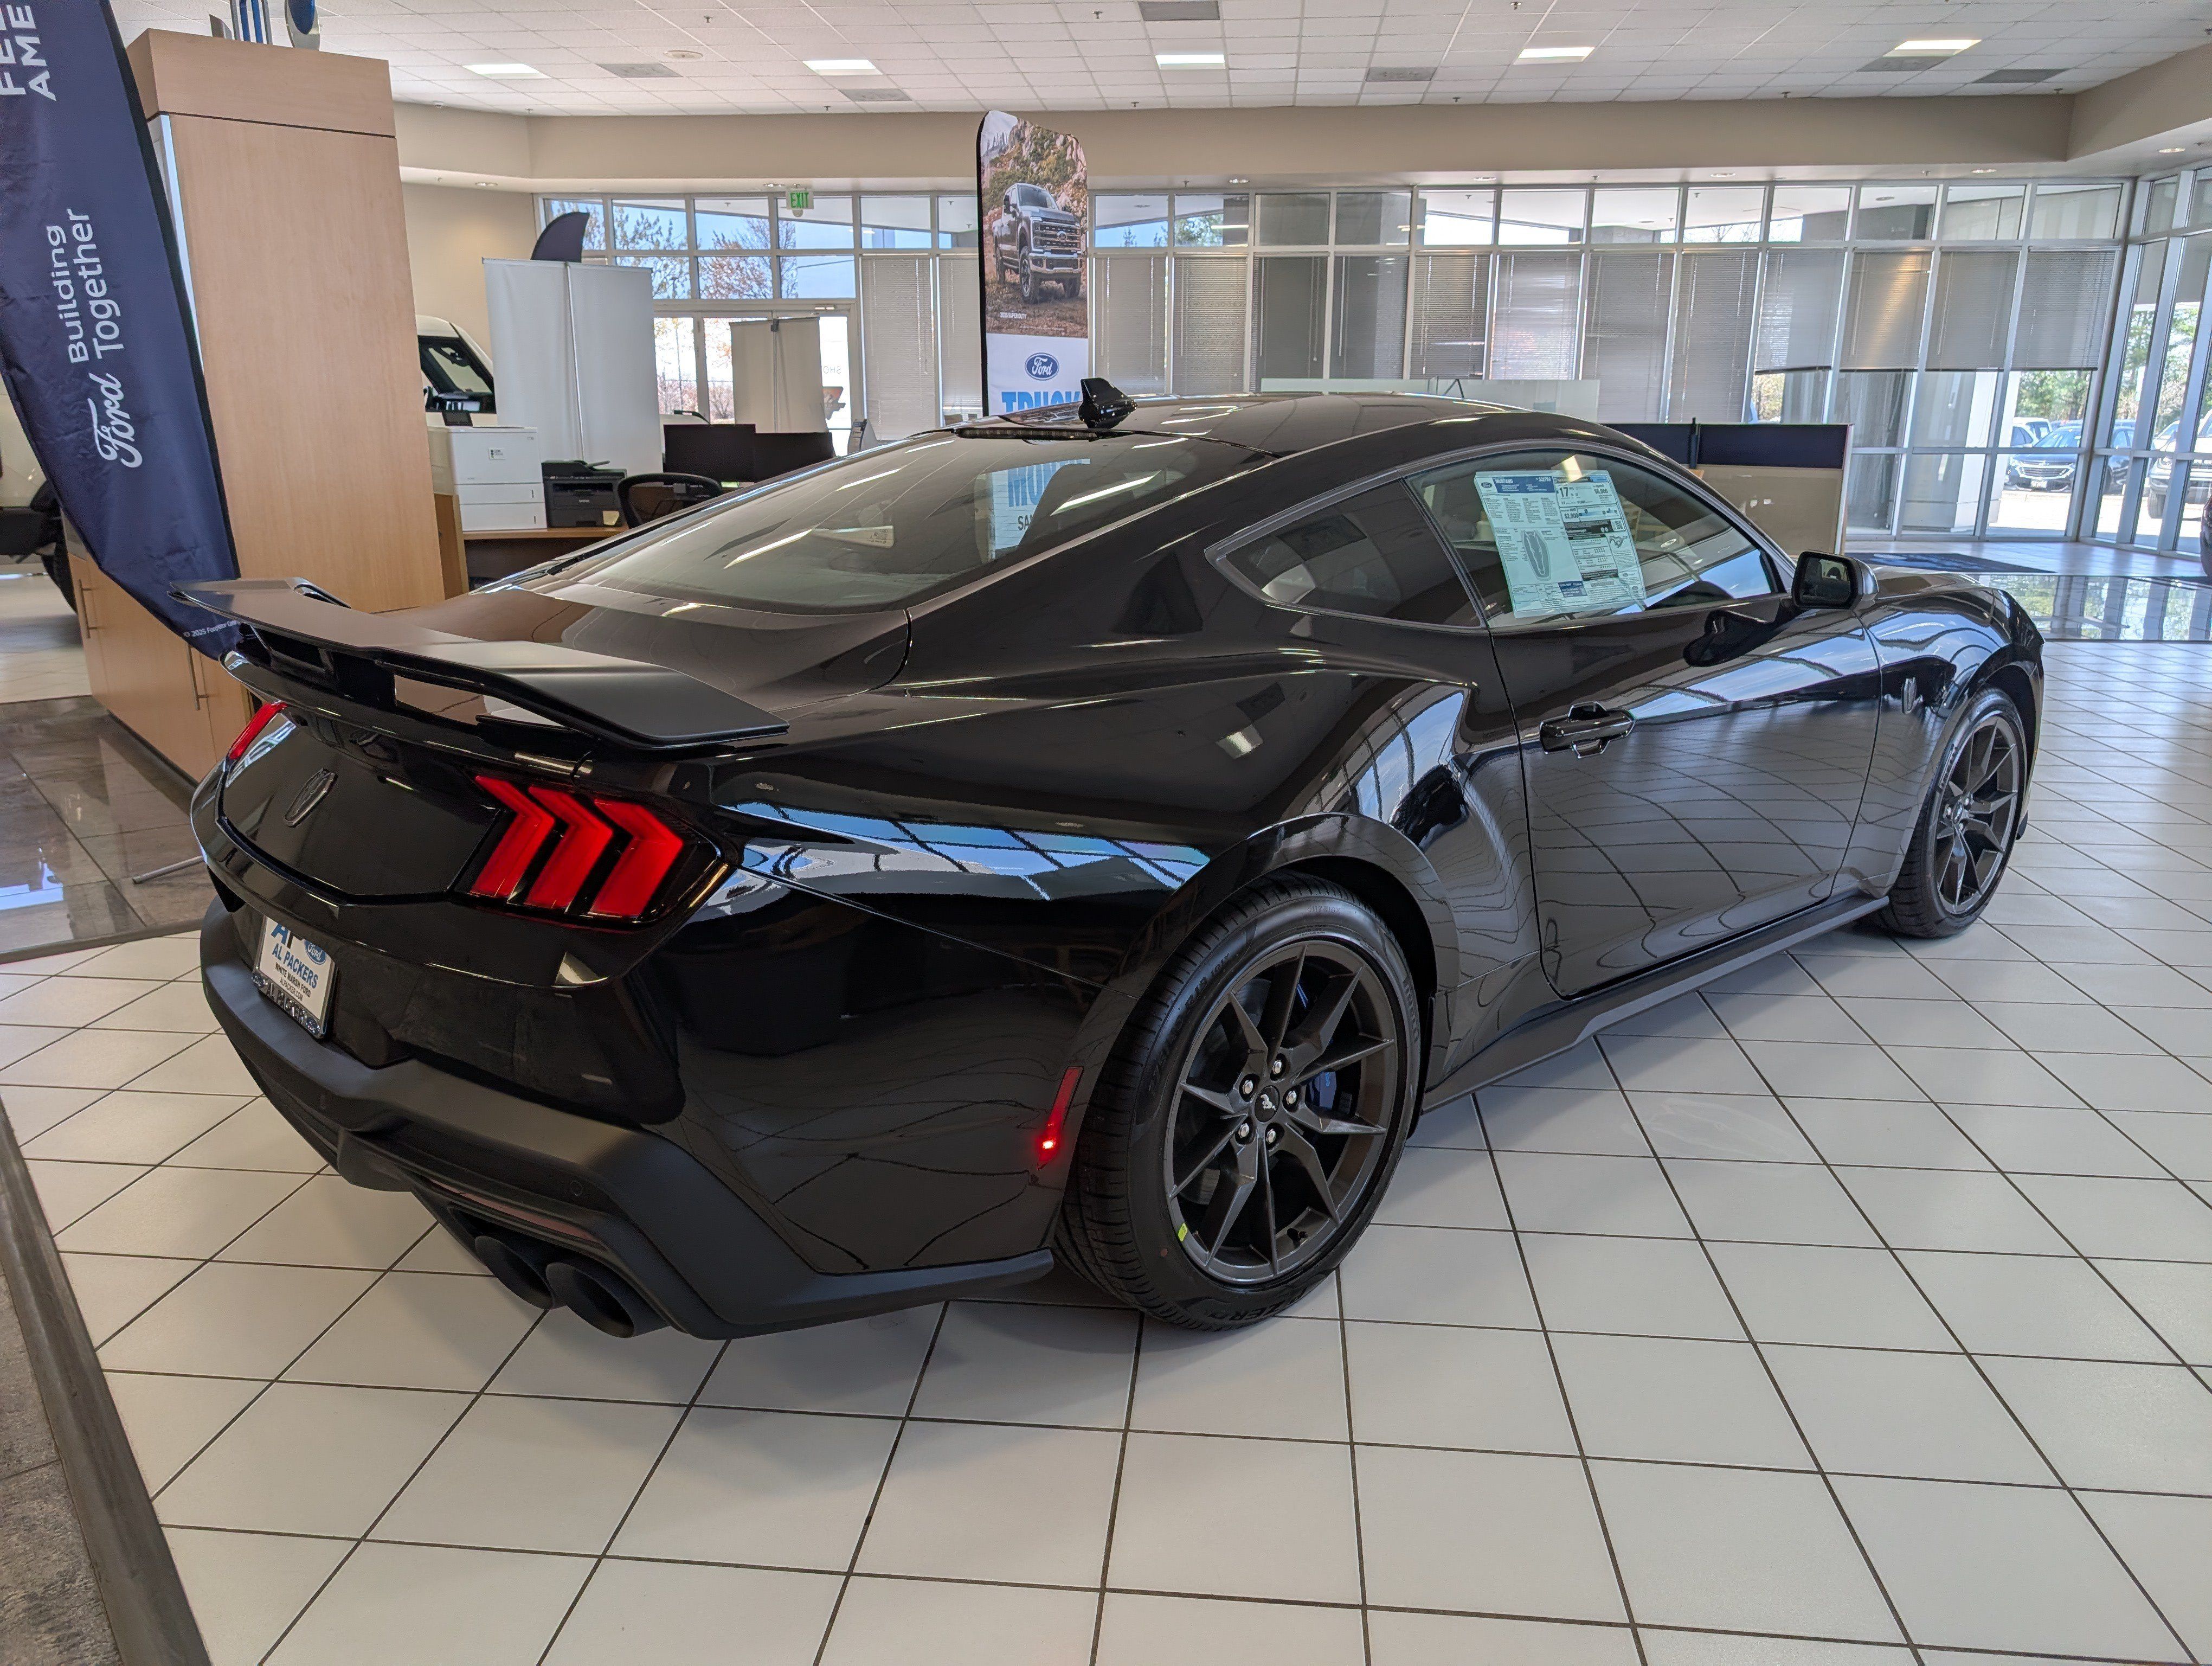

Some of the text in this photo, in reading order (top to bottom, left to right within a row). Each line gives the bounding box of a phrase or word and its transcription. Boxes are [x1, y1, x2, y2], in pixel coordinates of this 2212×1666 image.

[790, 192, 809, 208] EXIT
[67, 208, 124, 360] Together
[47, 226, 89, 364] Building
[1032, 357, 1053, 375] Ford
[87, 372, 143, 468] Ford
[1559, 486, 1568, 497] 17
[191, 629, 206, 637] 2025
[272, 943, 284, 960] AL
[284, 951, 319, 989] PACKERS
[275, 962, 287, 978] WHITE
